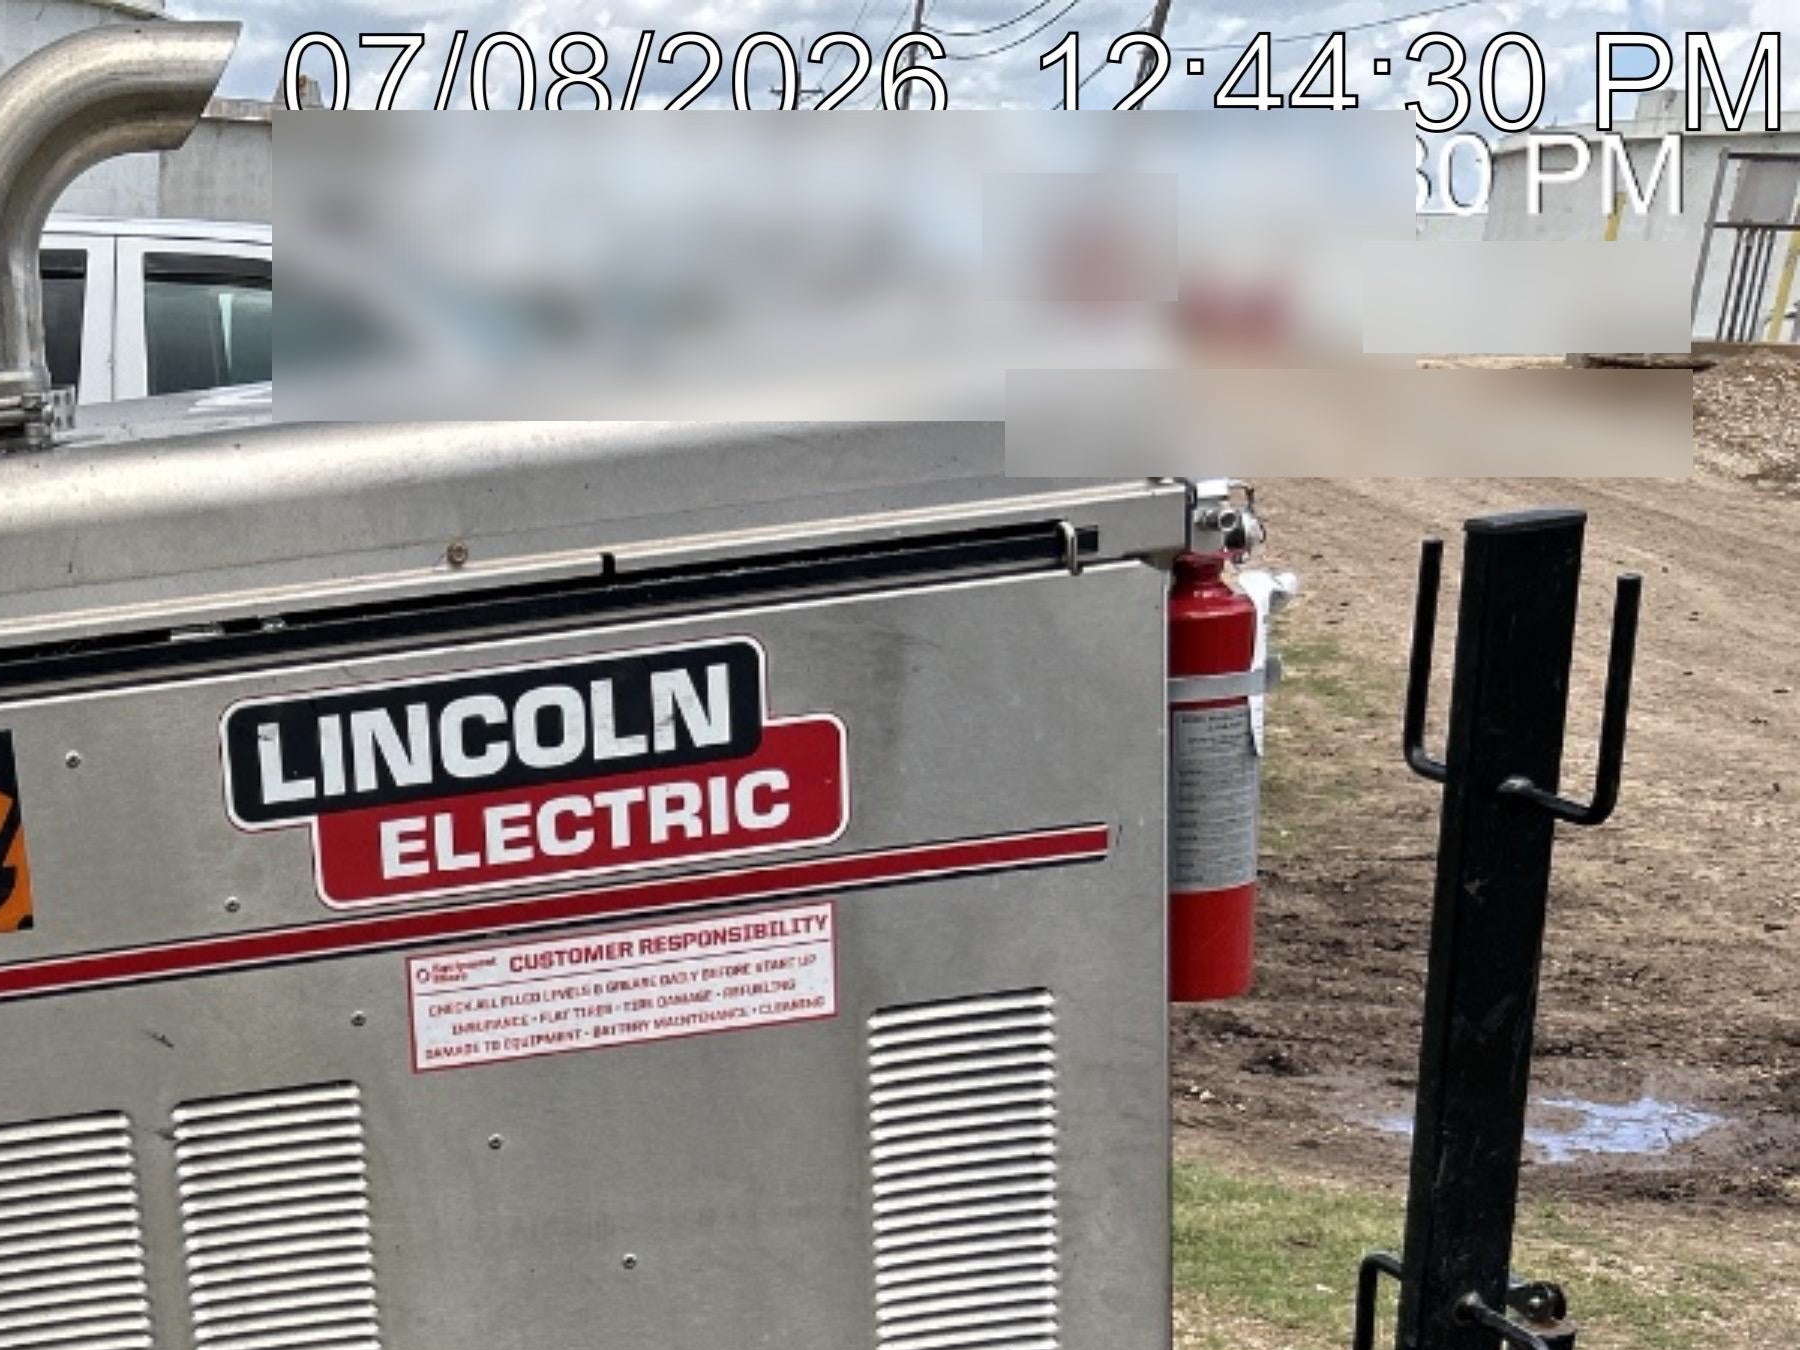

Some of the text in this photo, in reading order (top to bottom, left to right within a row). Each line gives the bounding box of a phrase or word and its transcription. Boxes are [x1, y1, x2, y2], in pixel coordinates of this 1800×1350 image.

[256, 662, 732, 805] LINCOLN
[379, 768, 791, 880] ELECTRIC
[509, 914, 828, 973] CUSTOMER RESPONSIBILITY
[701, 963, 751, 981] BEFORE
[503, 1029, 581, 1051] EQUIPMENT
